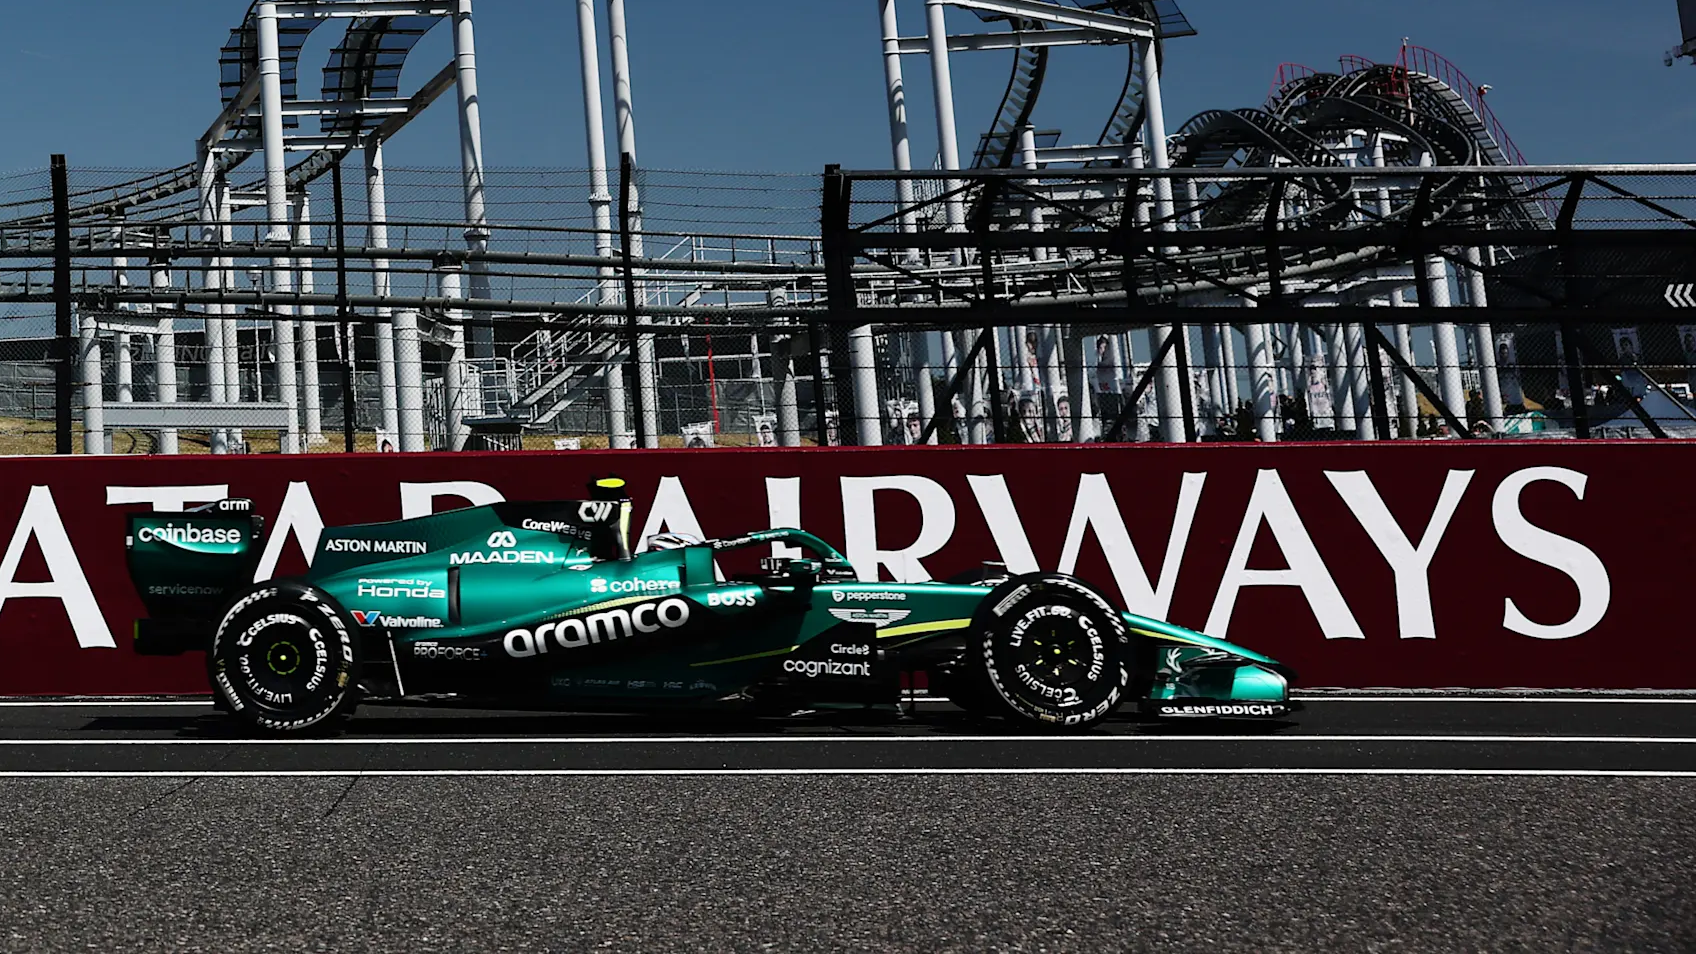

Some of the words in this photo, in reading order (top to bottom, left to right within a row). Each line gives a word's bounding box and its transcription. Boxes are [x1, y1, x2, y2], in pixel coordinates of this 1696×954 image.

[218, 499, 250, 511] arm
[138, 522, 242, 544] coinbase
[522, 518, 592, 541] CoreWeave
[325, 539, 371, 553] ASTON
[374, 539, 427, 554] MARTIN
[449, 550, 554, 565] MAADEN
[416, 579, 432, 587] by
[610, 577, 681, 593] cohere
[357, 585, 446, 598] Honda
[707, 591, 756, 607] BOSS
[847, 590, 906, 602] pepperstone
[317, 603, 353, 663] ZERO
[504, 598, 690, 658] aramco
[830, 643, 870, 655] Circle8
[1087, 628, 1105, 682] CELSIUS
[783, 659, 871, 677] cognizant
[1065, 686, 1121, 726] ZERO
[1161, 704, 1274, 716] GLENFIDDICH
